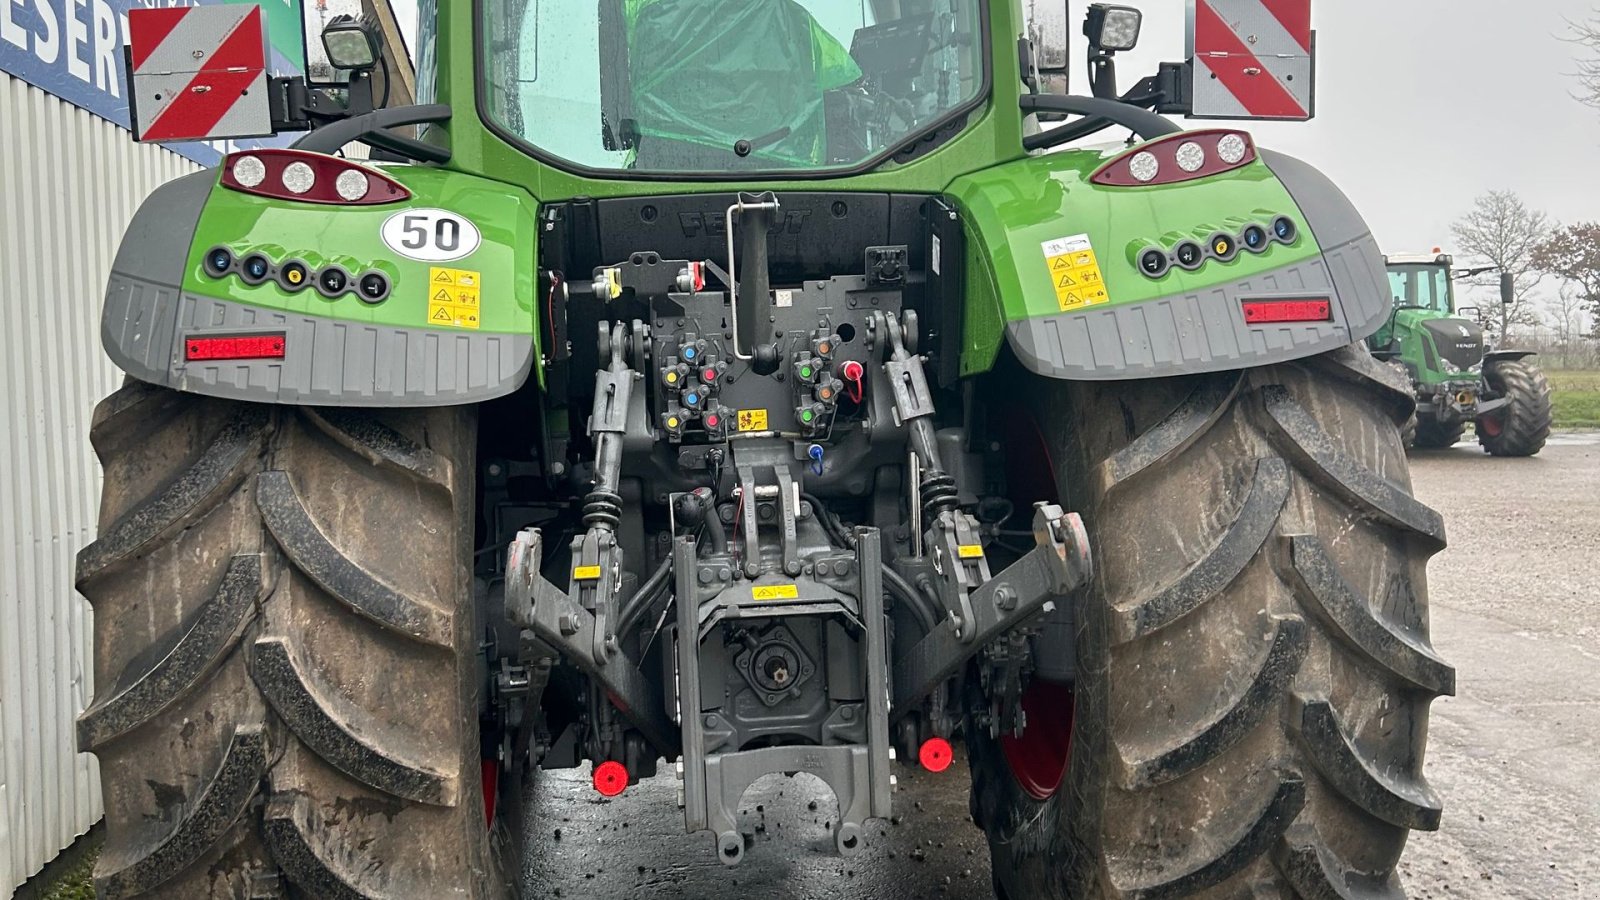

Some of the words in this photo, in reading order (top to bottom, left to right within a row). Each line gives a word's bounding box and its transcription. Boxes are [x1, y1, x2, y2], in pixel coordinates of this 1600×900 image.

[0, 0, 131, 98] ESER
[401, 215, 460, 251] 50
[677, 209, 812, 237] FET
